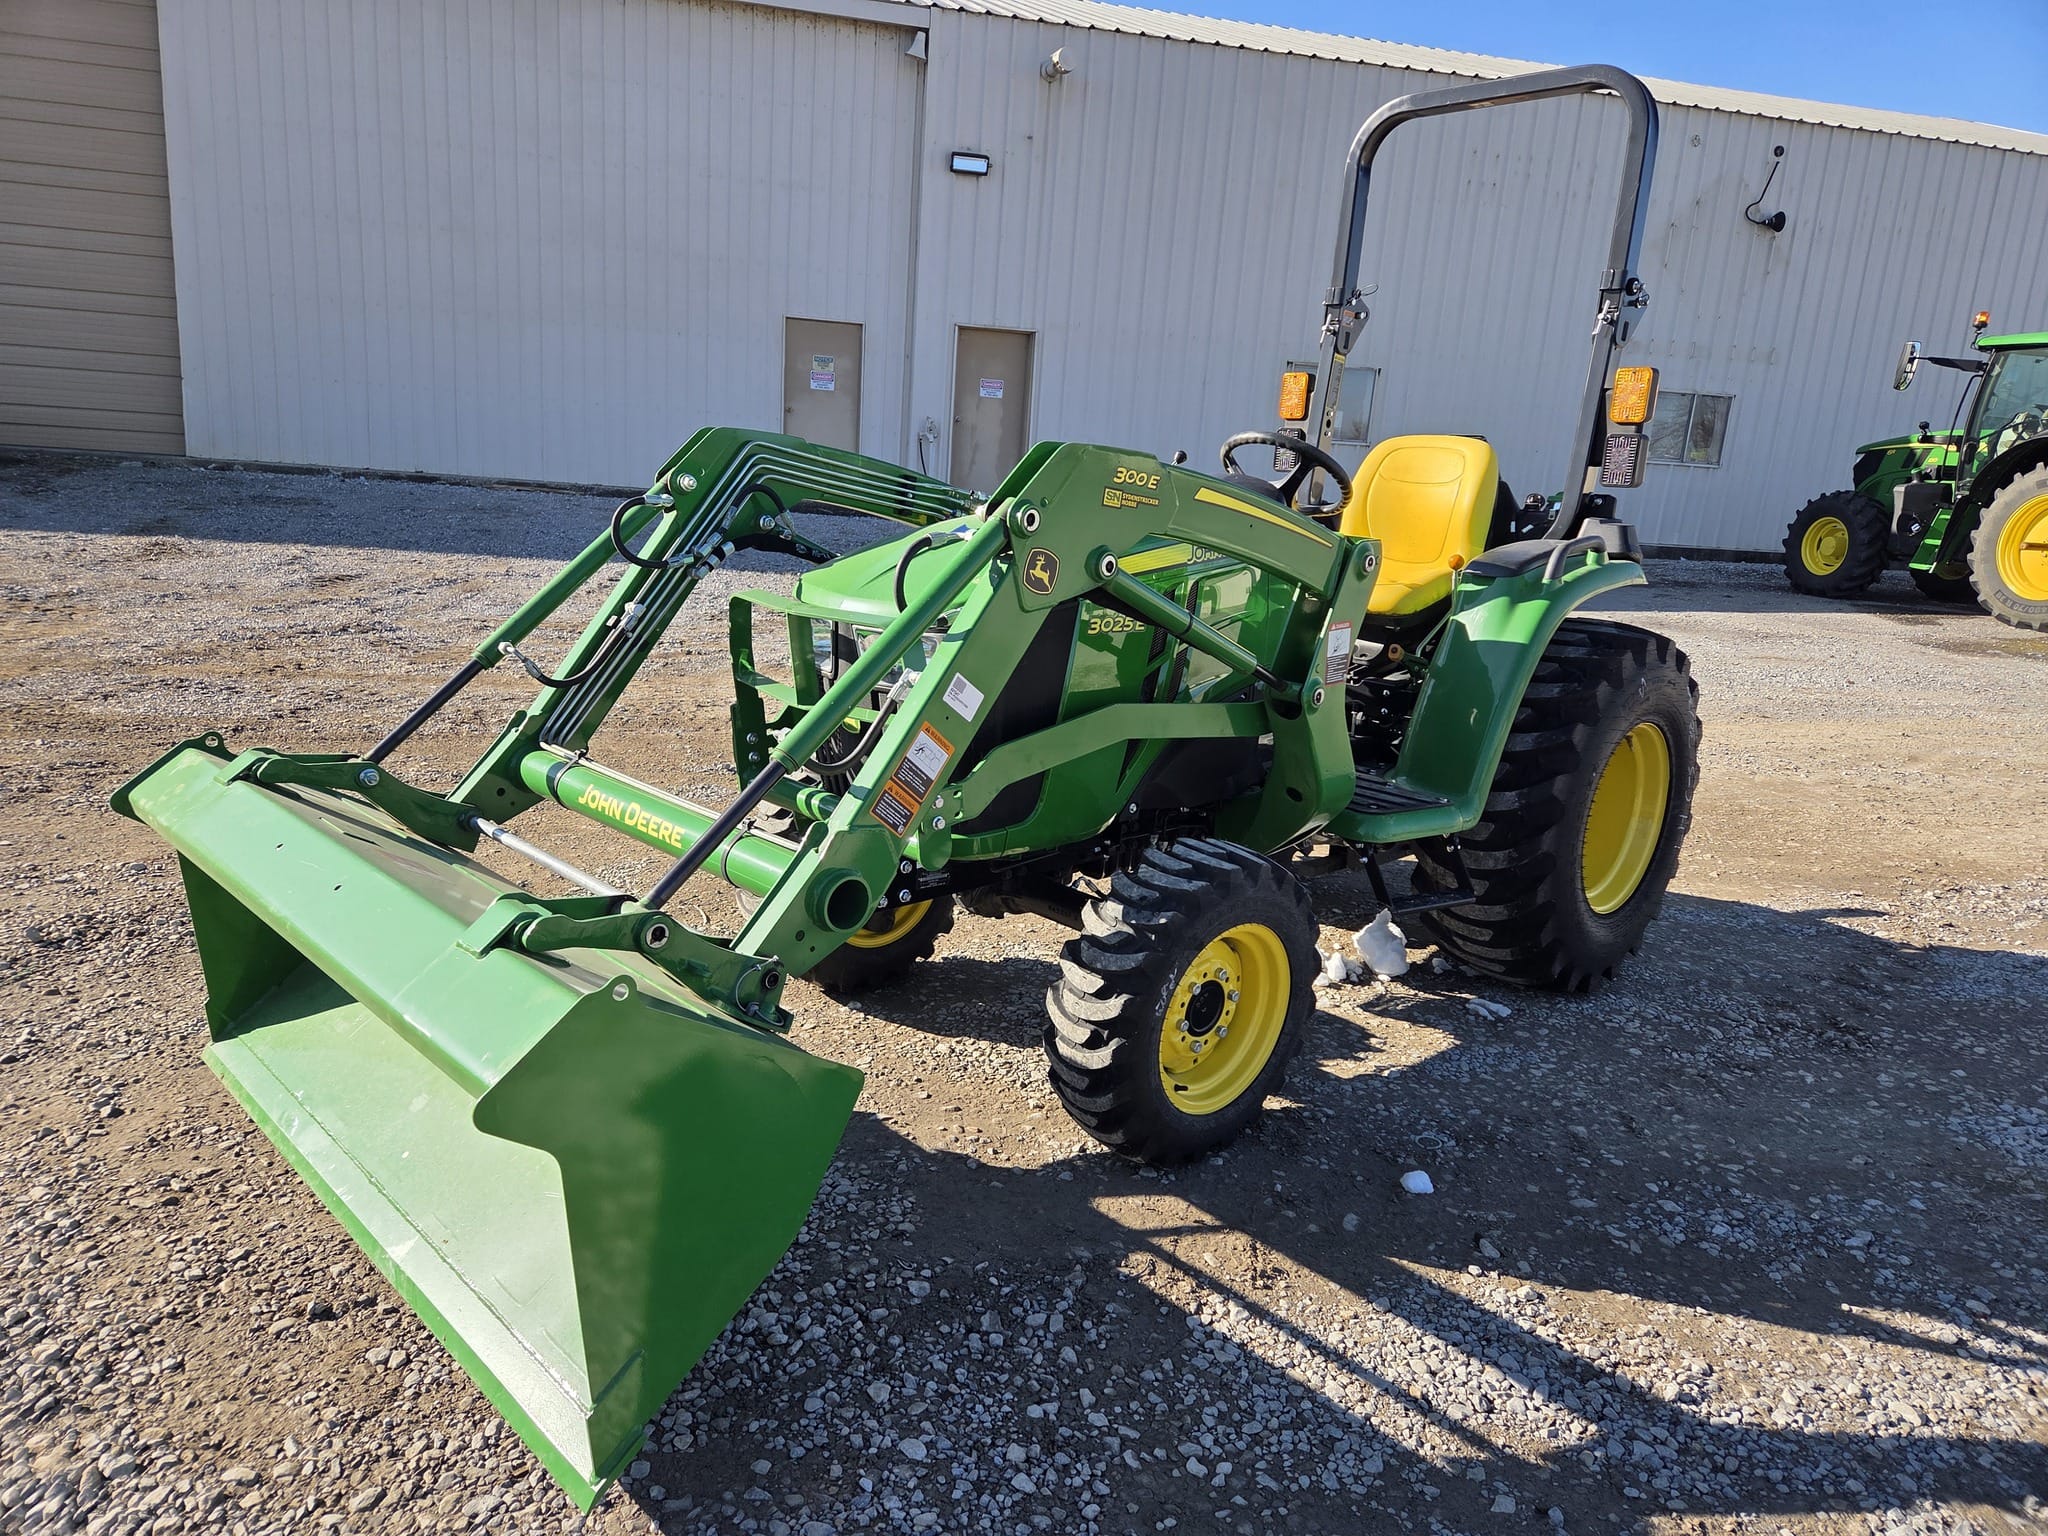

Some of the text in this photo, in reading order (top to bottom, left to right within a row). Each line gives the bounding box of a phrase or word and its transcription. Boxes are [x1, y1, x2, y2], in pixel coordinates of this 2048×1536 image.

[1088, 616, 1145, 635] 3025E
[578, 784, 685, 848] JOHN DEERE
